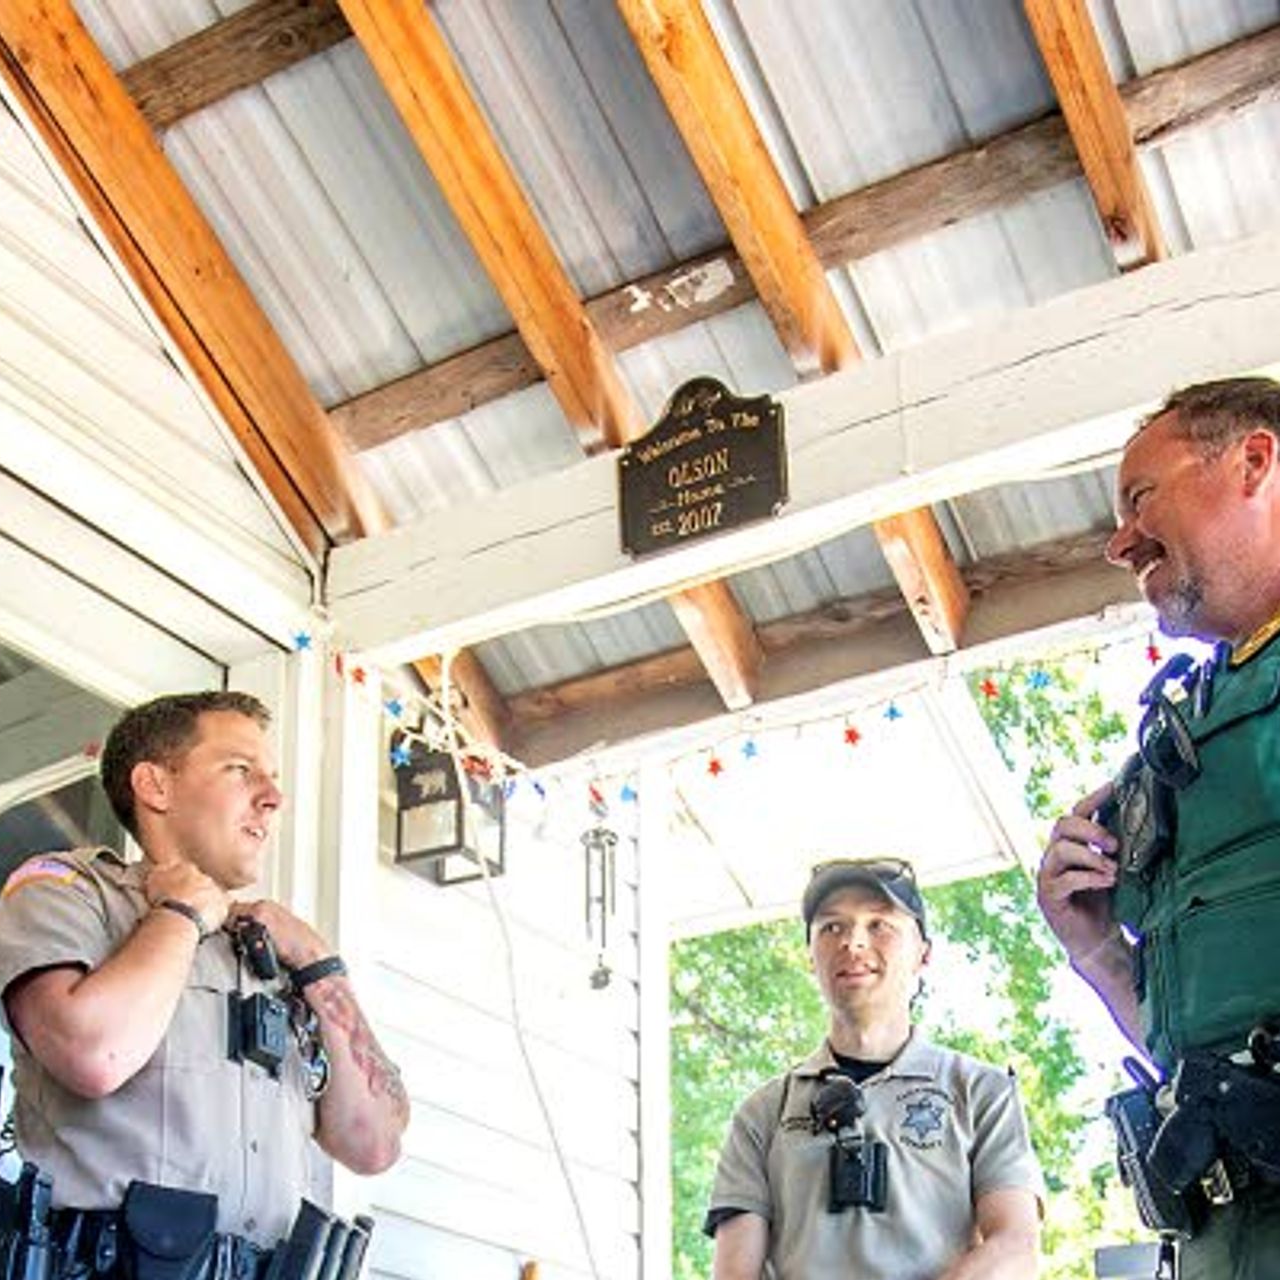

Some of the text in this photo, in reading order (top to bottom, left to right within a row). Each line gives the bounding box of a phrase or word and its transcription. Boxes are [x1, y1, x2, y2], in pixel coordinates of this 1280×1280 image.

[637, 428, 702, 463] Welcome
[731, 412, 760, 428] The
[668, 448, 730, 487] OLSON
[677, 502, 723, 536] 2007
